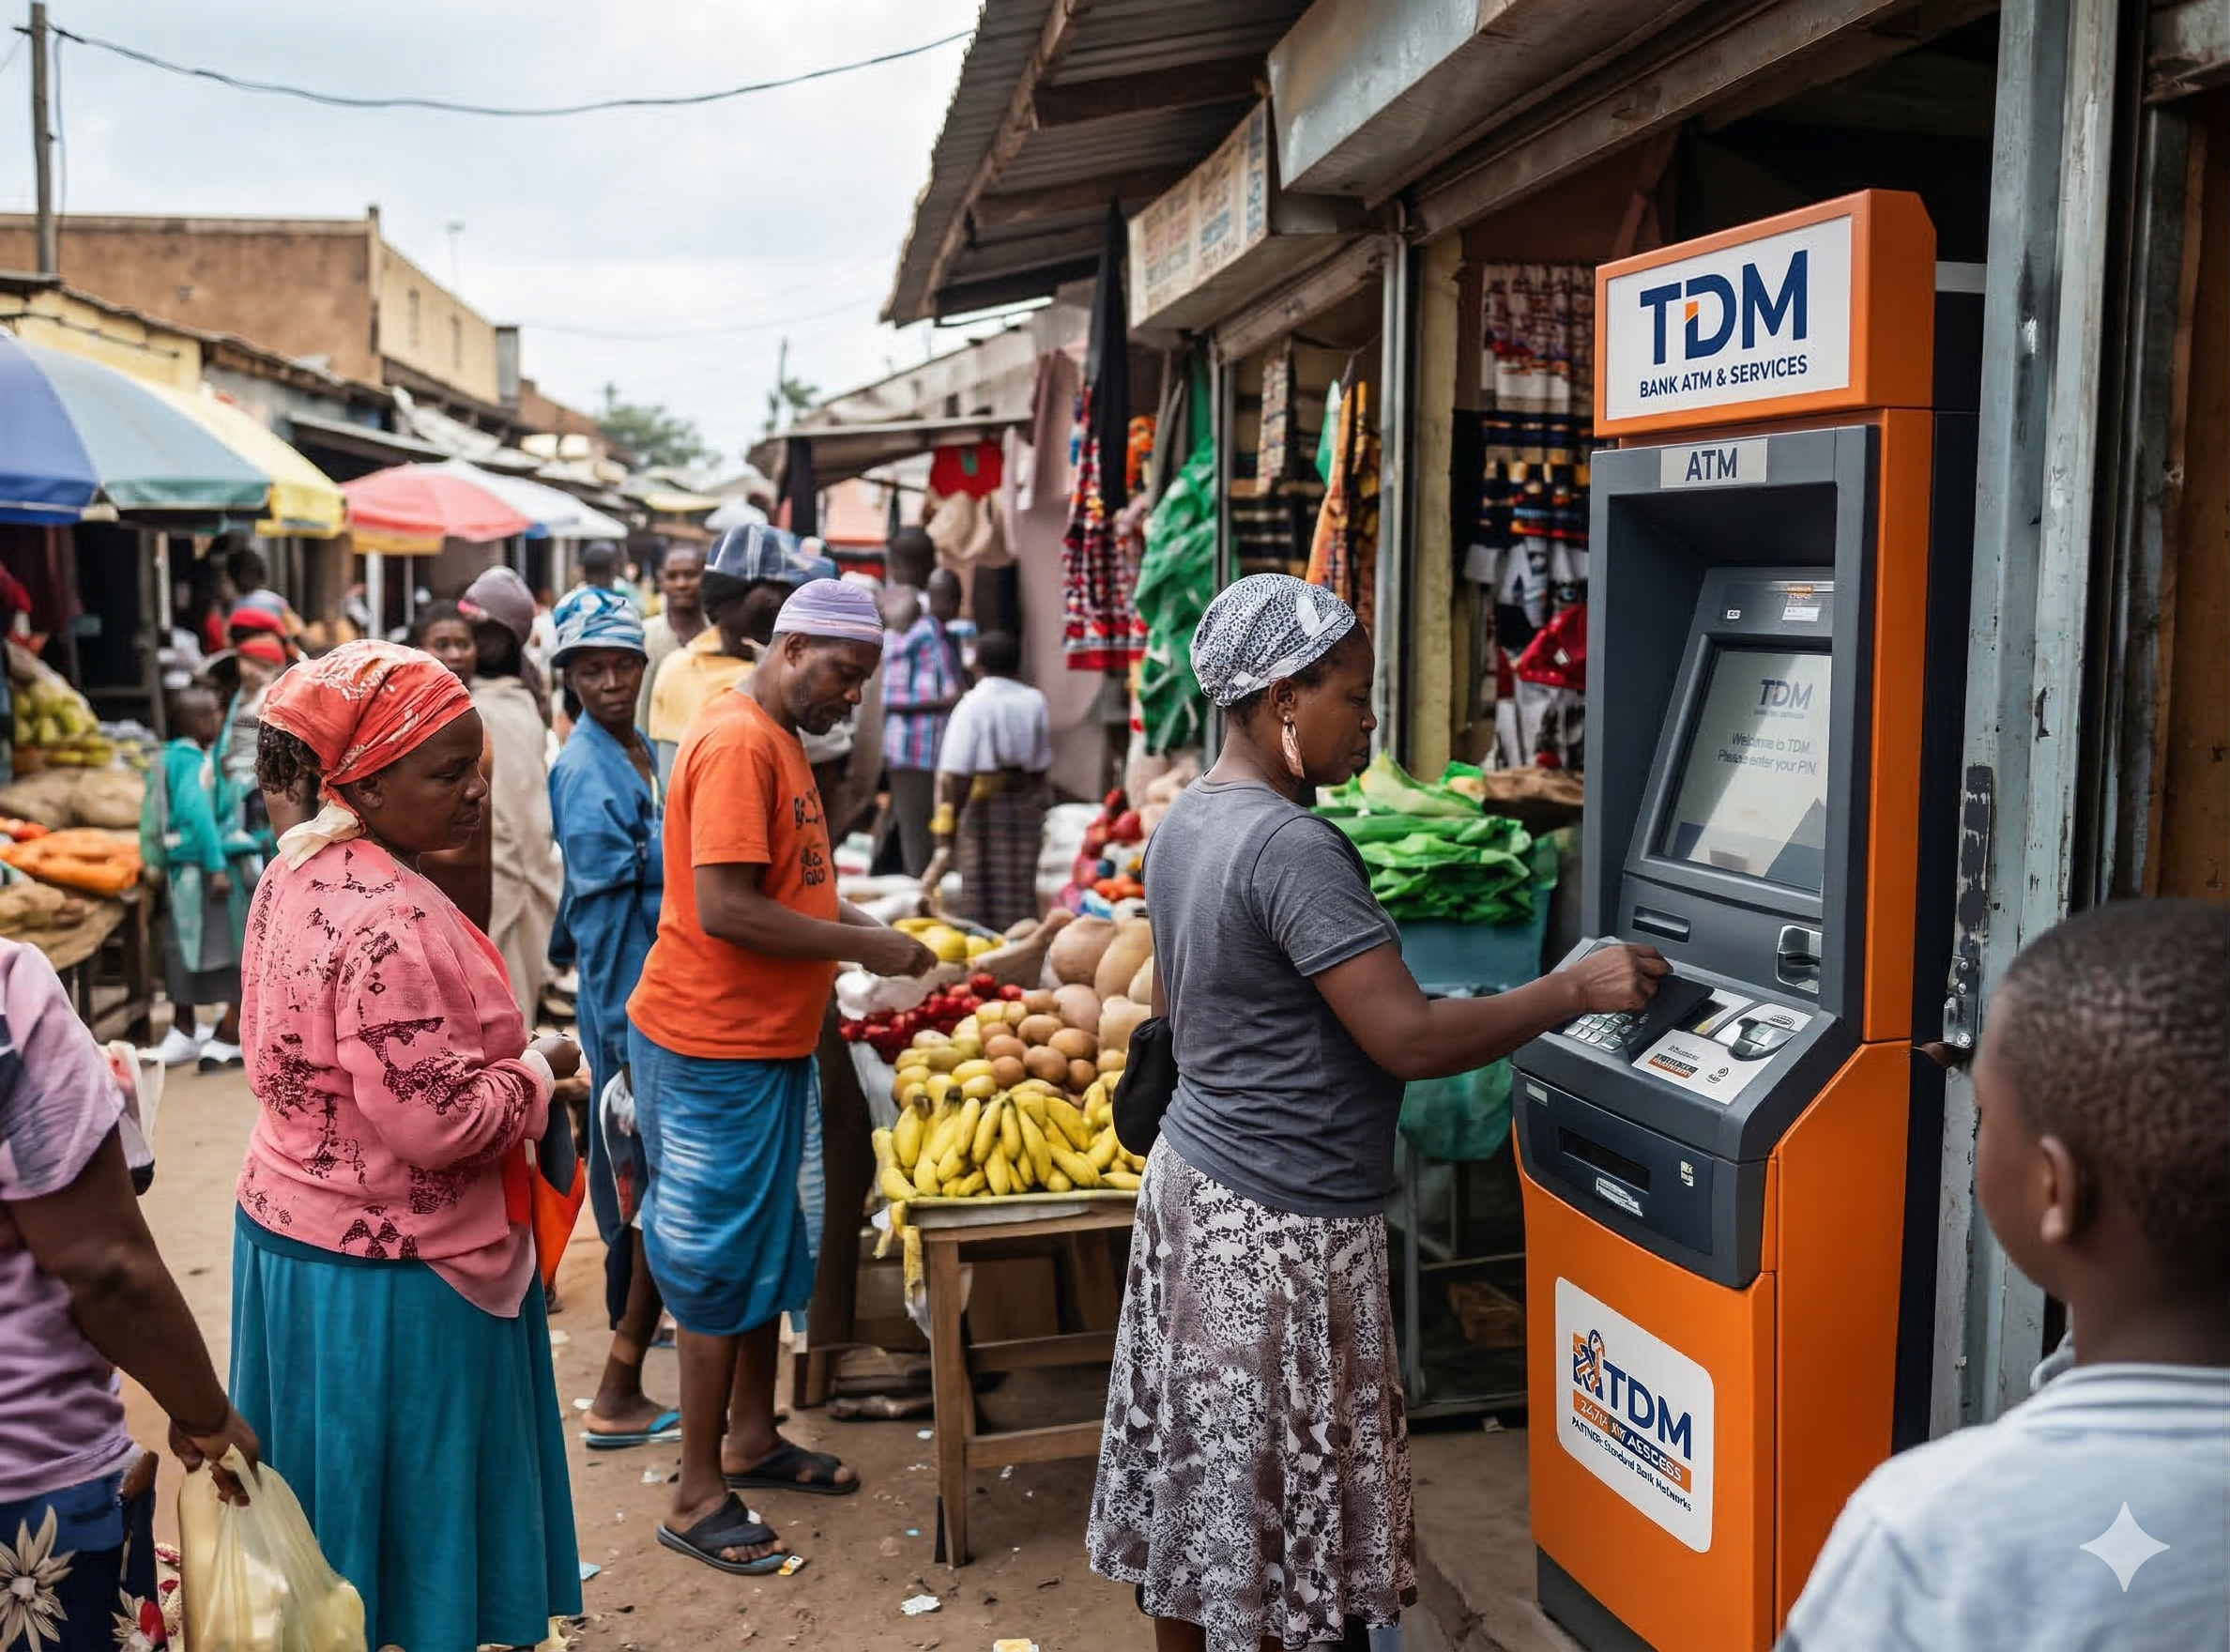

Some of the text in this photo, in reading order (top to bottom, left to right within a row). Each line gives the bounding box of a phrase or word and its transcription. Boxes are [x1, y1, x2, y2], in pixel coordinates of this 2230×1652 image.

[1640, 249, 1809, 366] TDM
[1640, 354, 1809, 399] BANK ATM & SERVICES
[1685, 447, 1737, 482] ATM
[1760, 679, 1813, 710] TDM
[1732, 731, 1774, 750] Welcome
[1718, 748, 1749, 765] Please
[1749, 756, 1775, 769] enter
[1775, 758, 1796, 773] your
[1603, 1358, 1692, 1461] TDM
